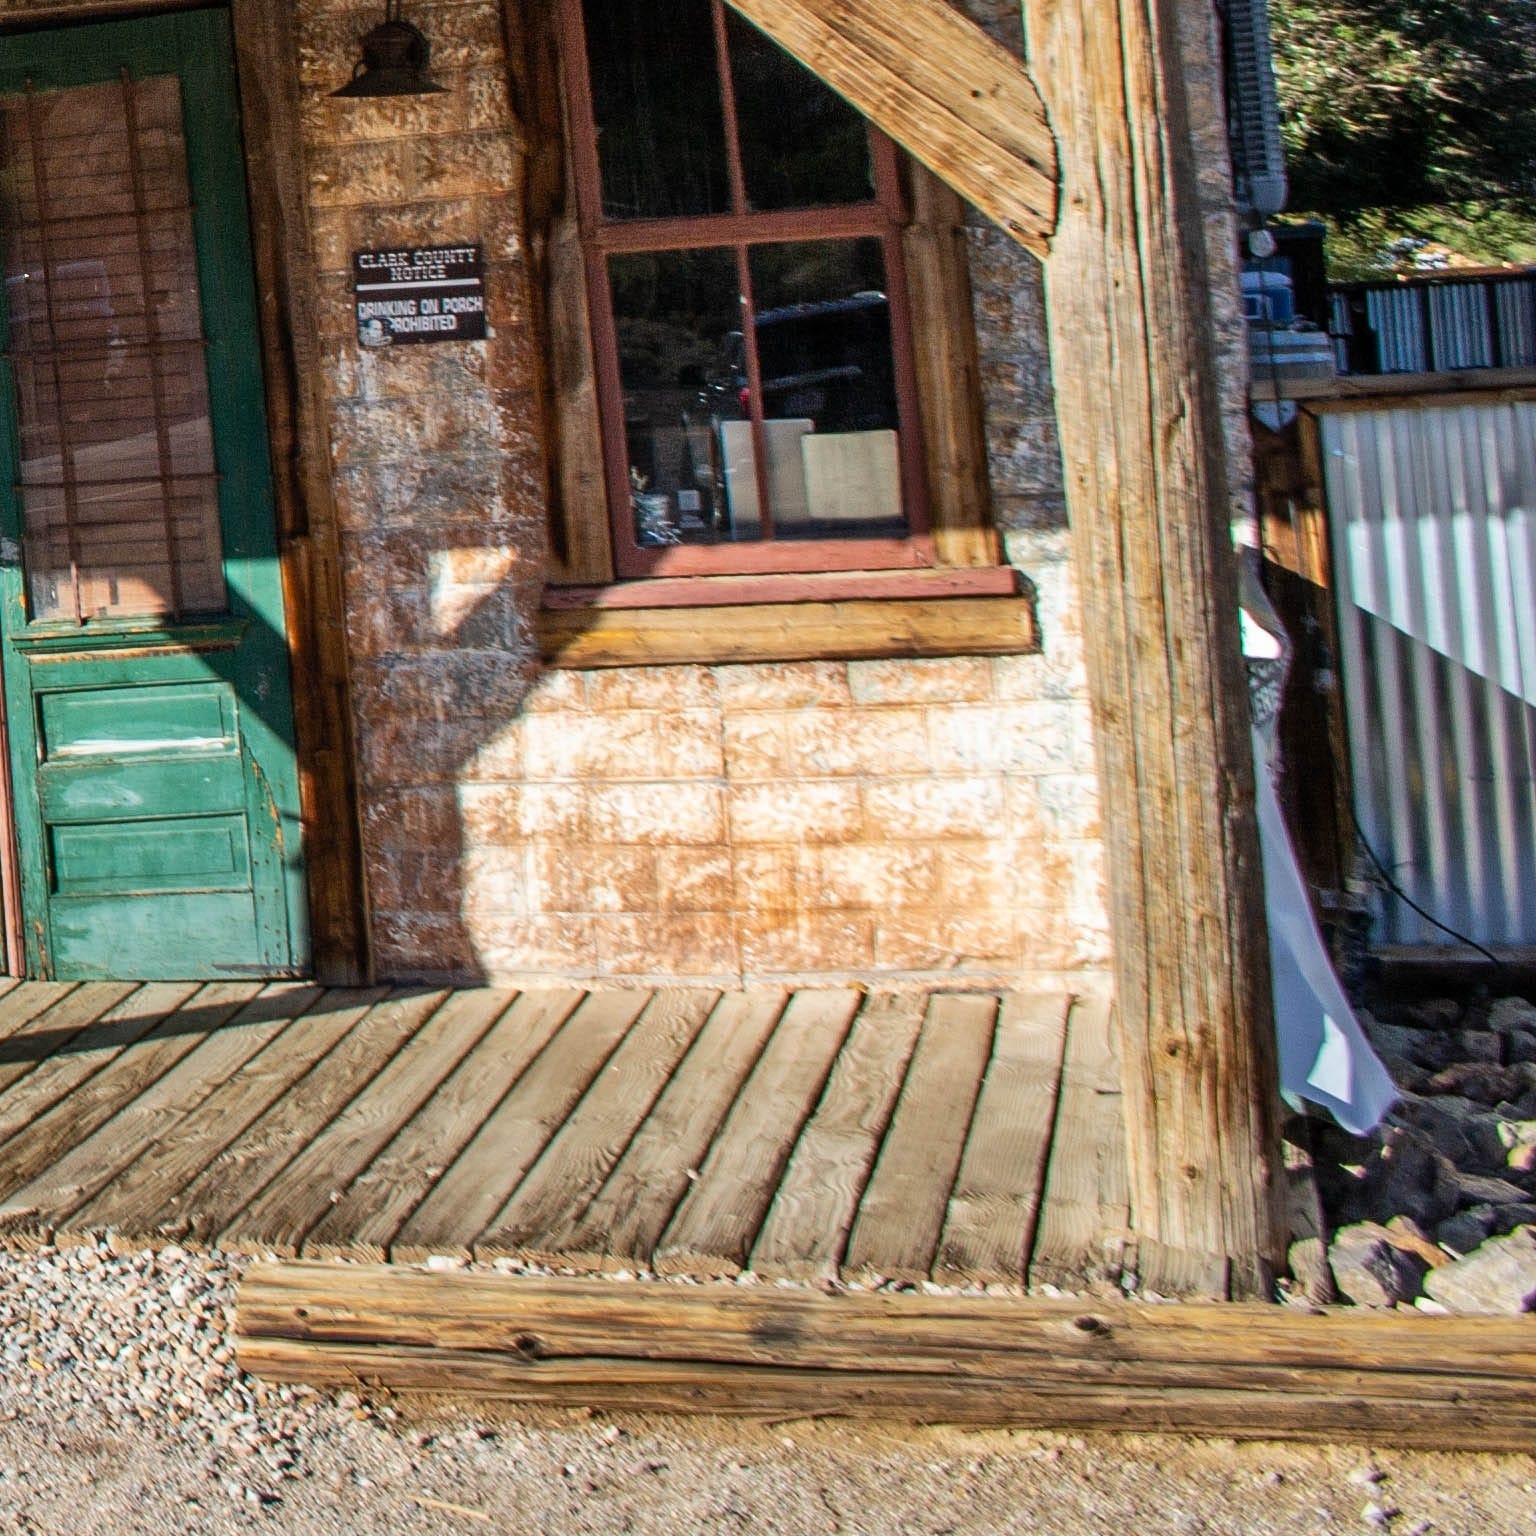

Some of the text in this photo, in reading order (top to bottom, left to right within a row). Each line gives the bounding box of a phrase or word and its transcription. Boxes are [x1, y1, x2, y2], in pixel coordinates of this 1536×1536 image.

[359, 248, 476, 268] CLARK COUNTY
[390, 264, 446, 281] NOTICE
[358, 296, 484, 320] DRINKING ON PORCH
